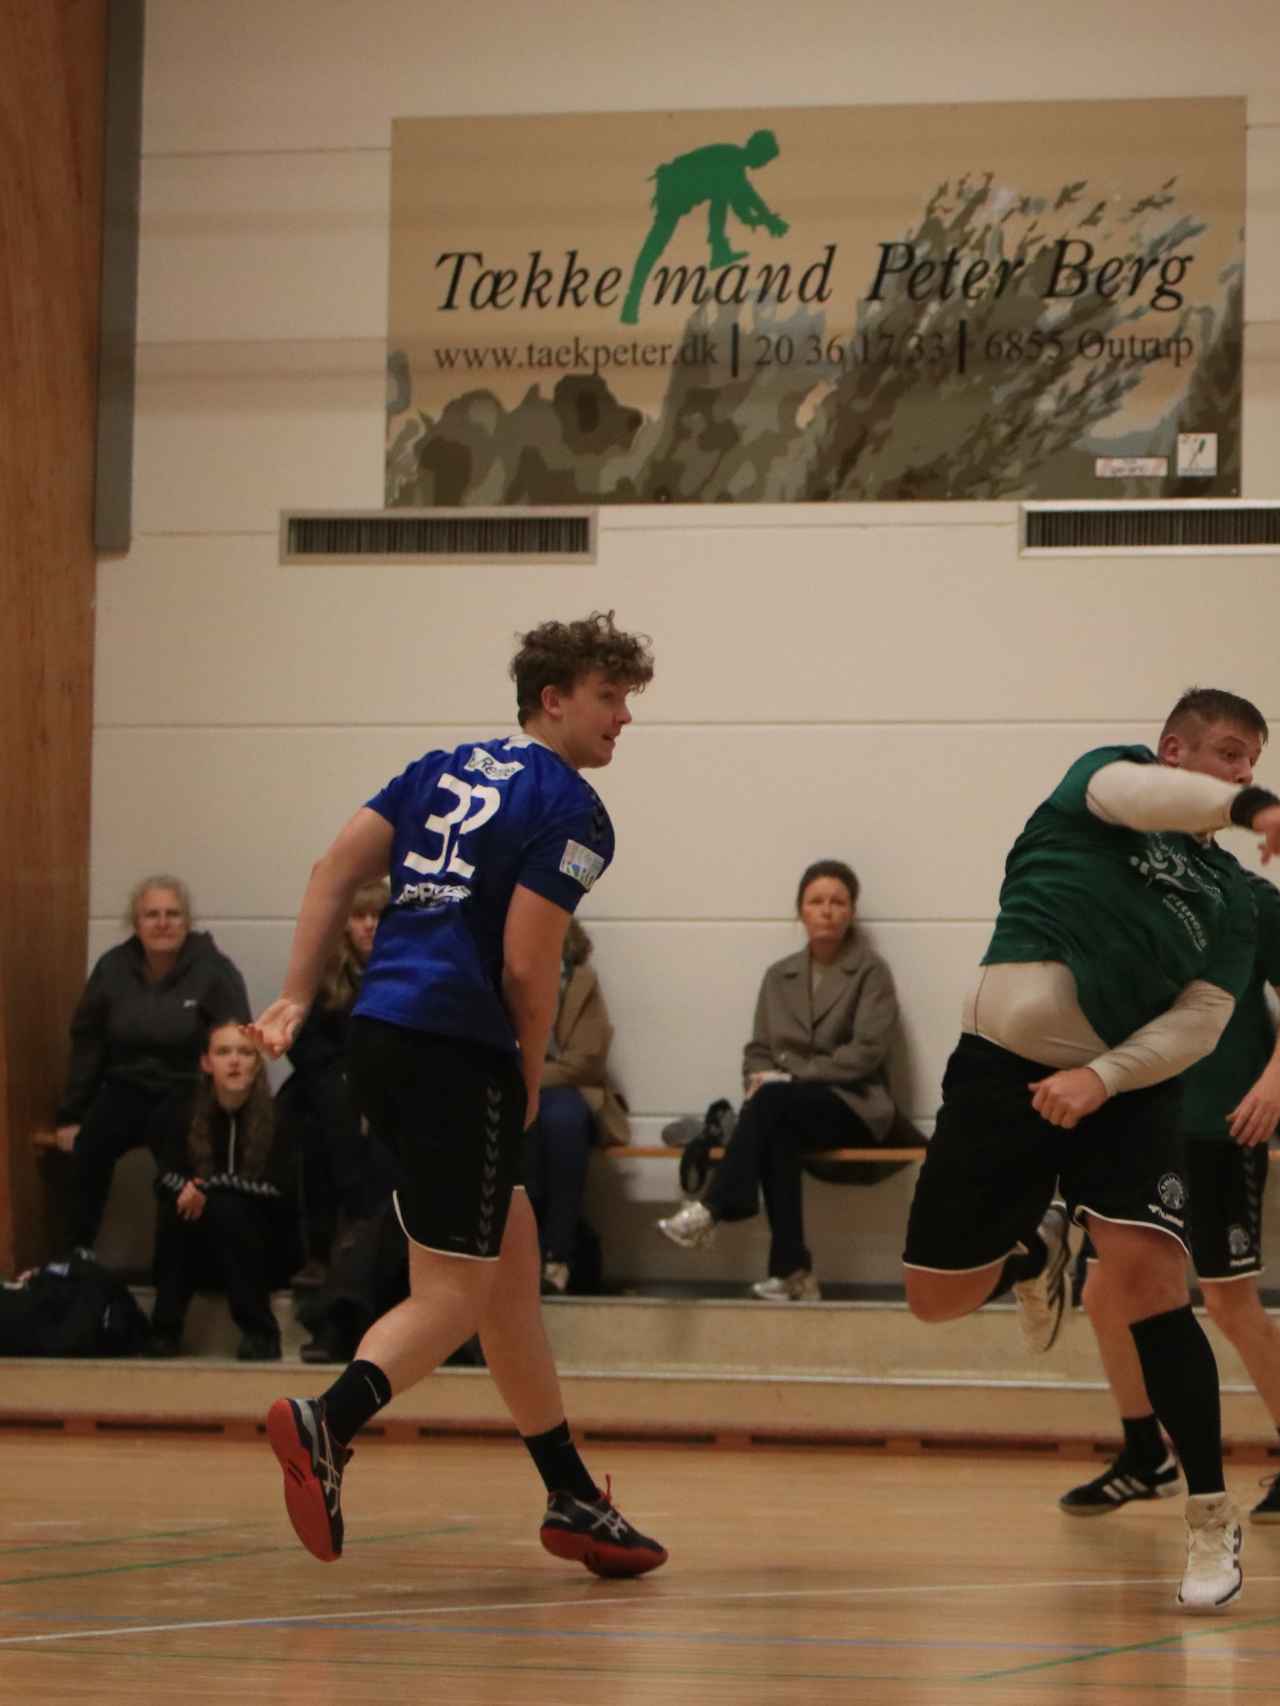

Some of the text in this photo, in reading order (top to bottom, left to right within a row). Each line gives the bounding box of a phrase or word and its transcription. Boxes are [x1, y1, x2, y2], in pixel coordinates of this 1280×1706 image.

[865, 241, 1025, 302] Peter
[1041, 237, 1195, 311] Berg
[434, 334, 719, 377] www.taekpeter.dk
[755, 335, 794, 367] 20
[805, 333, 846, 367] 36
[984, 329, 1066, 363] 6855
[1078, 328, 1194, 368] Outrup
[403, 772, 501, 880] 32
